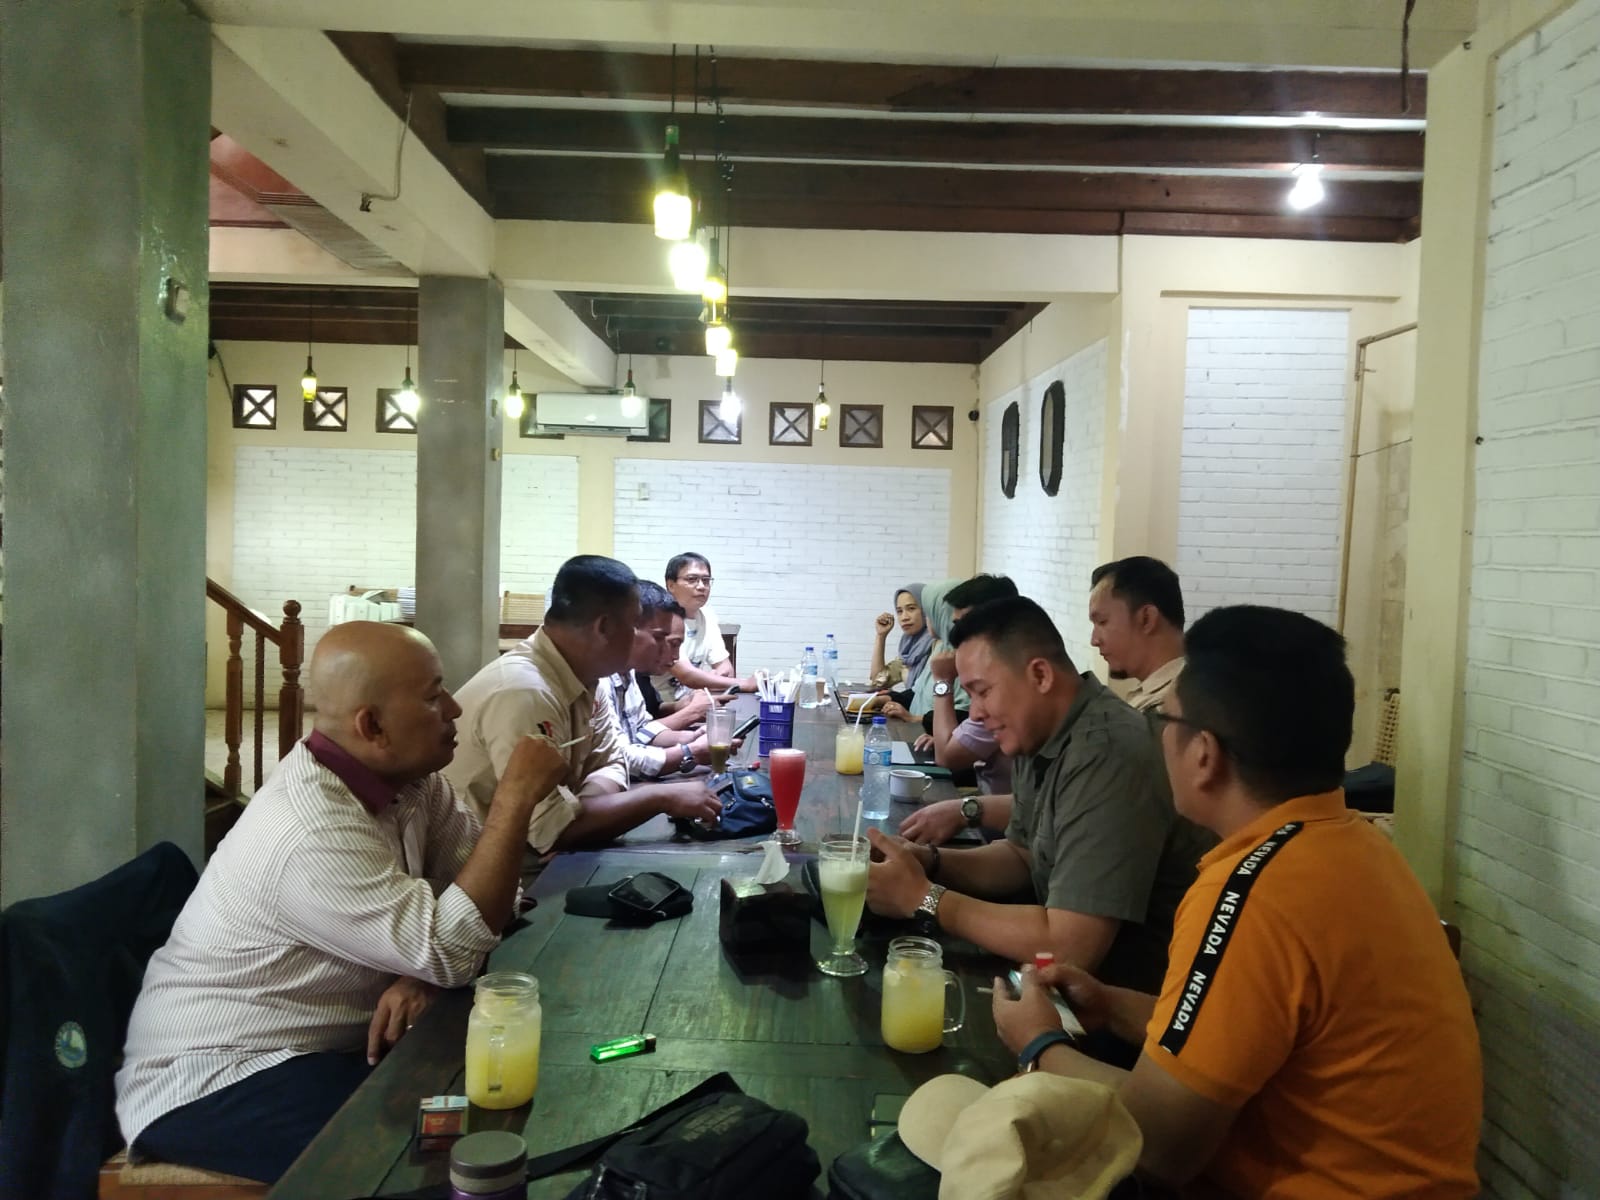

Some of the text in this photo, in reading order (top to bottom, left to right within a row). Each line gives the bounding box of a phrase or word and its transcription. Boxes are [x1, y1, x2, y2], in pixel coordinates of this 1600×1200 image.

[1236, 841, 1278, 875] NEVADA
[1203, 890, 1240, 955] NEVADA
[1172, 970, 1207, 1031] NEVADA
